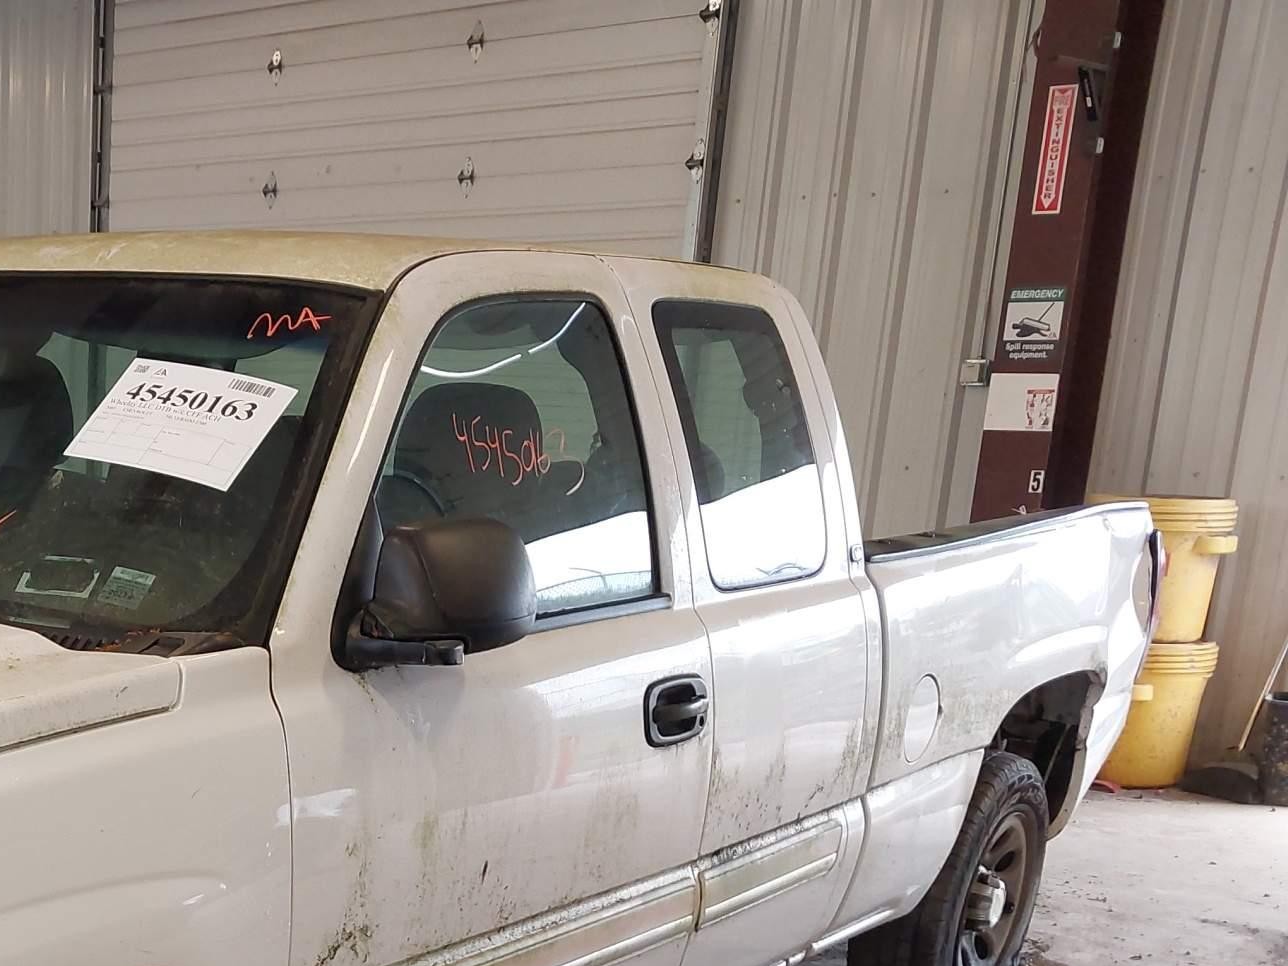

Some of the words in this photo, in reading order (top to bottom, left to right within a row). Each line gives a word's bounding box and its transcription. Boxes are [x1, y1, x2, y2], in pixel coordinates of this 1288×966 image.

[1044, 108, 1063, 199] EXTINGUISHER
[1011, 289, 1064, 299] EMERGENCY
[1005, 342, 1022, 351] Spill
[1022, 343, 1054, 351] response
[1009, 352, 1048, 361] equipment.
[126, 382, 258, 421] 45450163
[1031, 471, 1042, 491] 5
